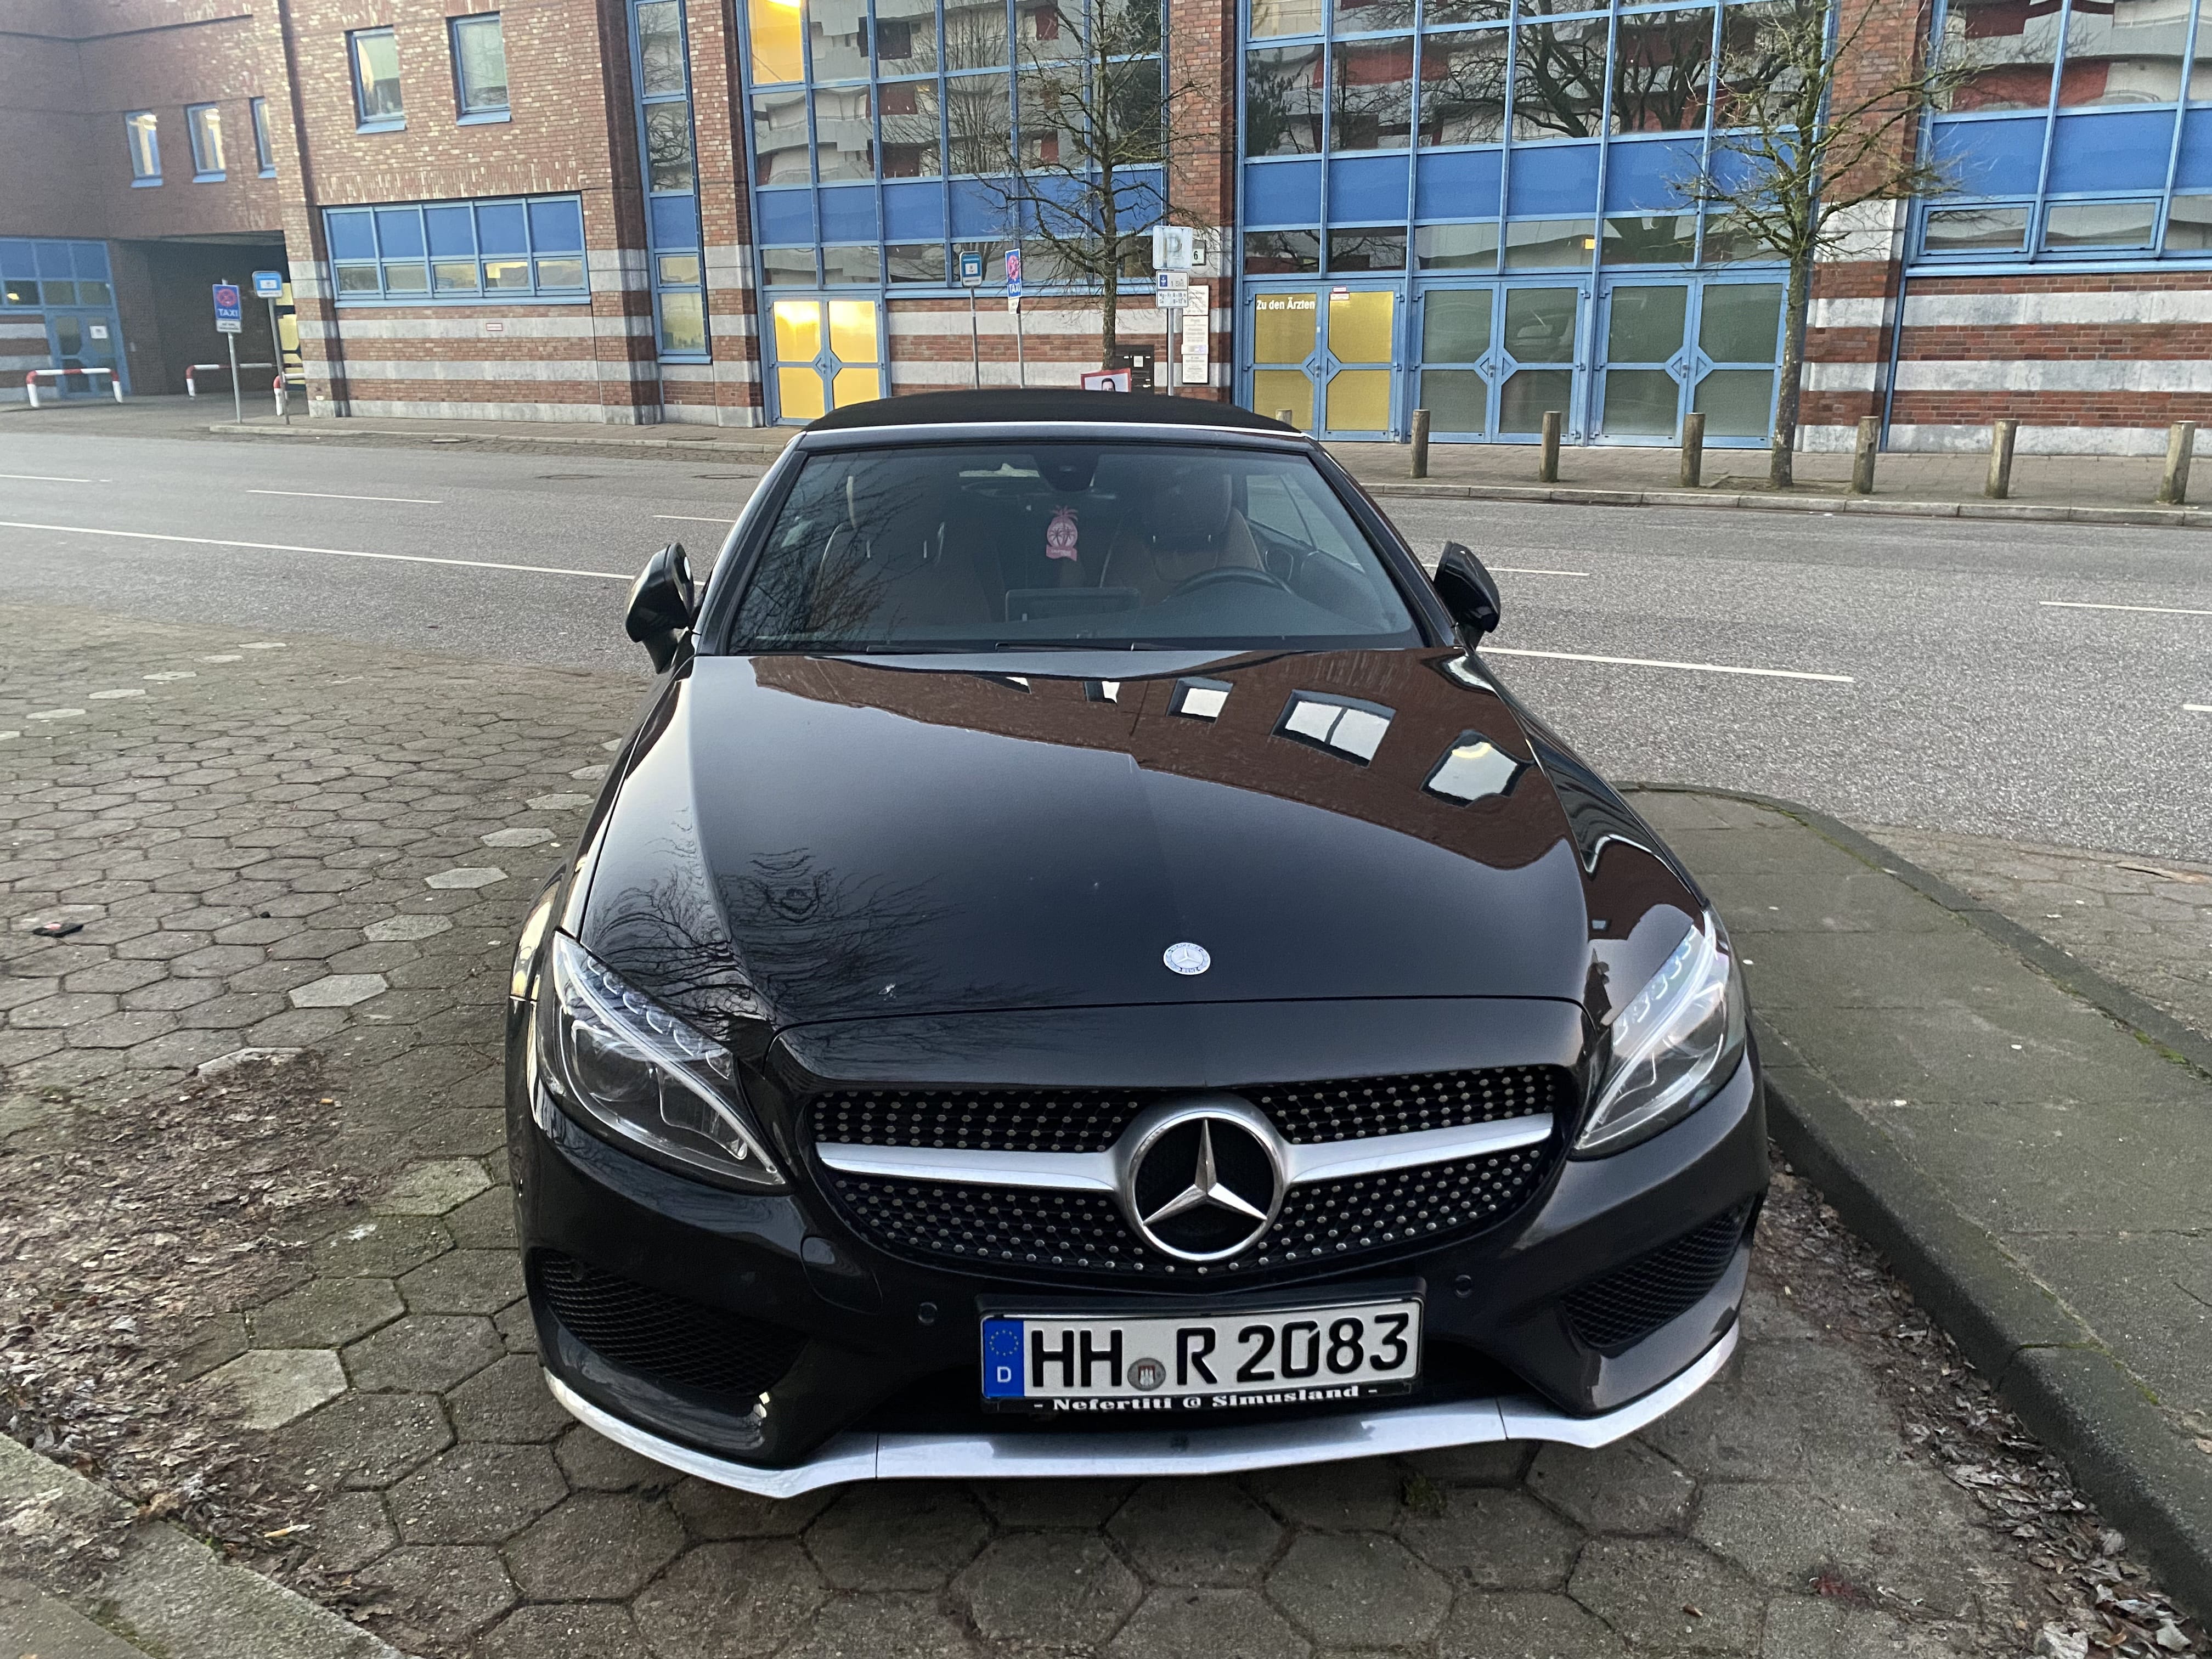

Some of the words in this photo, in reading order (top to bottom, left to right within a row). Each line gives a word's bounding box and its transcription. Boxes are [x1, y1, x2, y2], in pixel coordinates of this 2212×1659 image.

[1193, 251, 1198, 260] 6
[1009, 283, 1020, 294] TAXI
[1256, 300, 1267, 310] Zu
[1269, 300, 1285, 310] den
[1286, 297, 1316, 310] Ärzten
[218, 308, 238, 317] TAXI
[1031, 1329, 1122, 1387] HH
[1176, 1327, 1218, 1386] R
[1237, 1312, 1409, 1383] 2083
[997, 1366, 1012, 1383] D
[1053, 1397, 1172, 1410] Nefertiti
[1212, 1385, 1359, 1408] Simusland
